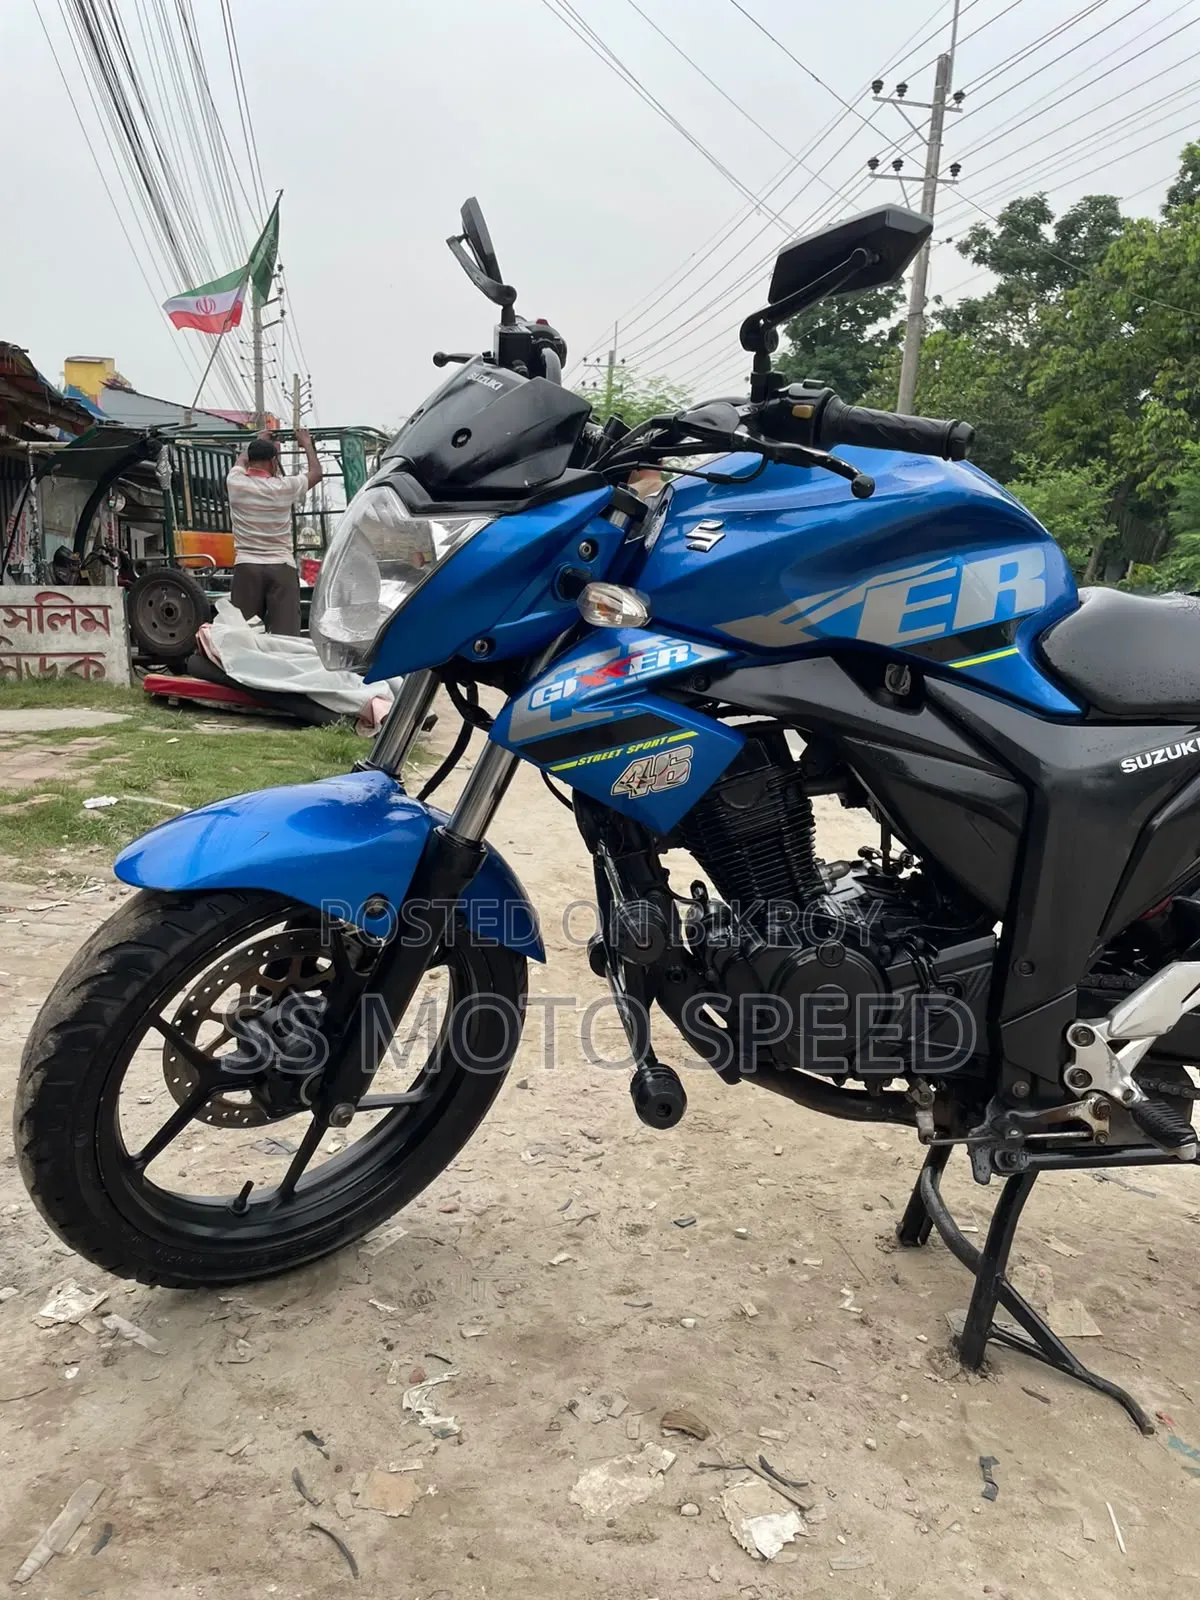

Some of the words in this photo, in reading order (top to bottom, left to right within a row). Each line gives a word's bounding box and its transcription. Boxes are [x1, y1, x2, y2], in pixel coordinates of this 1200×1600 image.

[467, 372, 503, 391] SUZUKI
[576, 748, 623, 766] STREET
[626, 736, 669, 754] SPORT
[611, 745, 694, 799] 46
